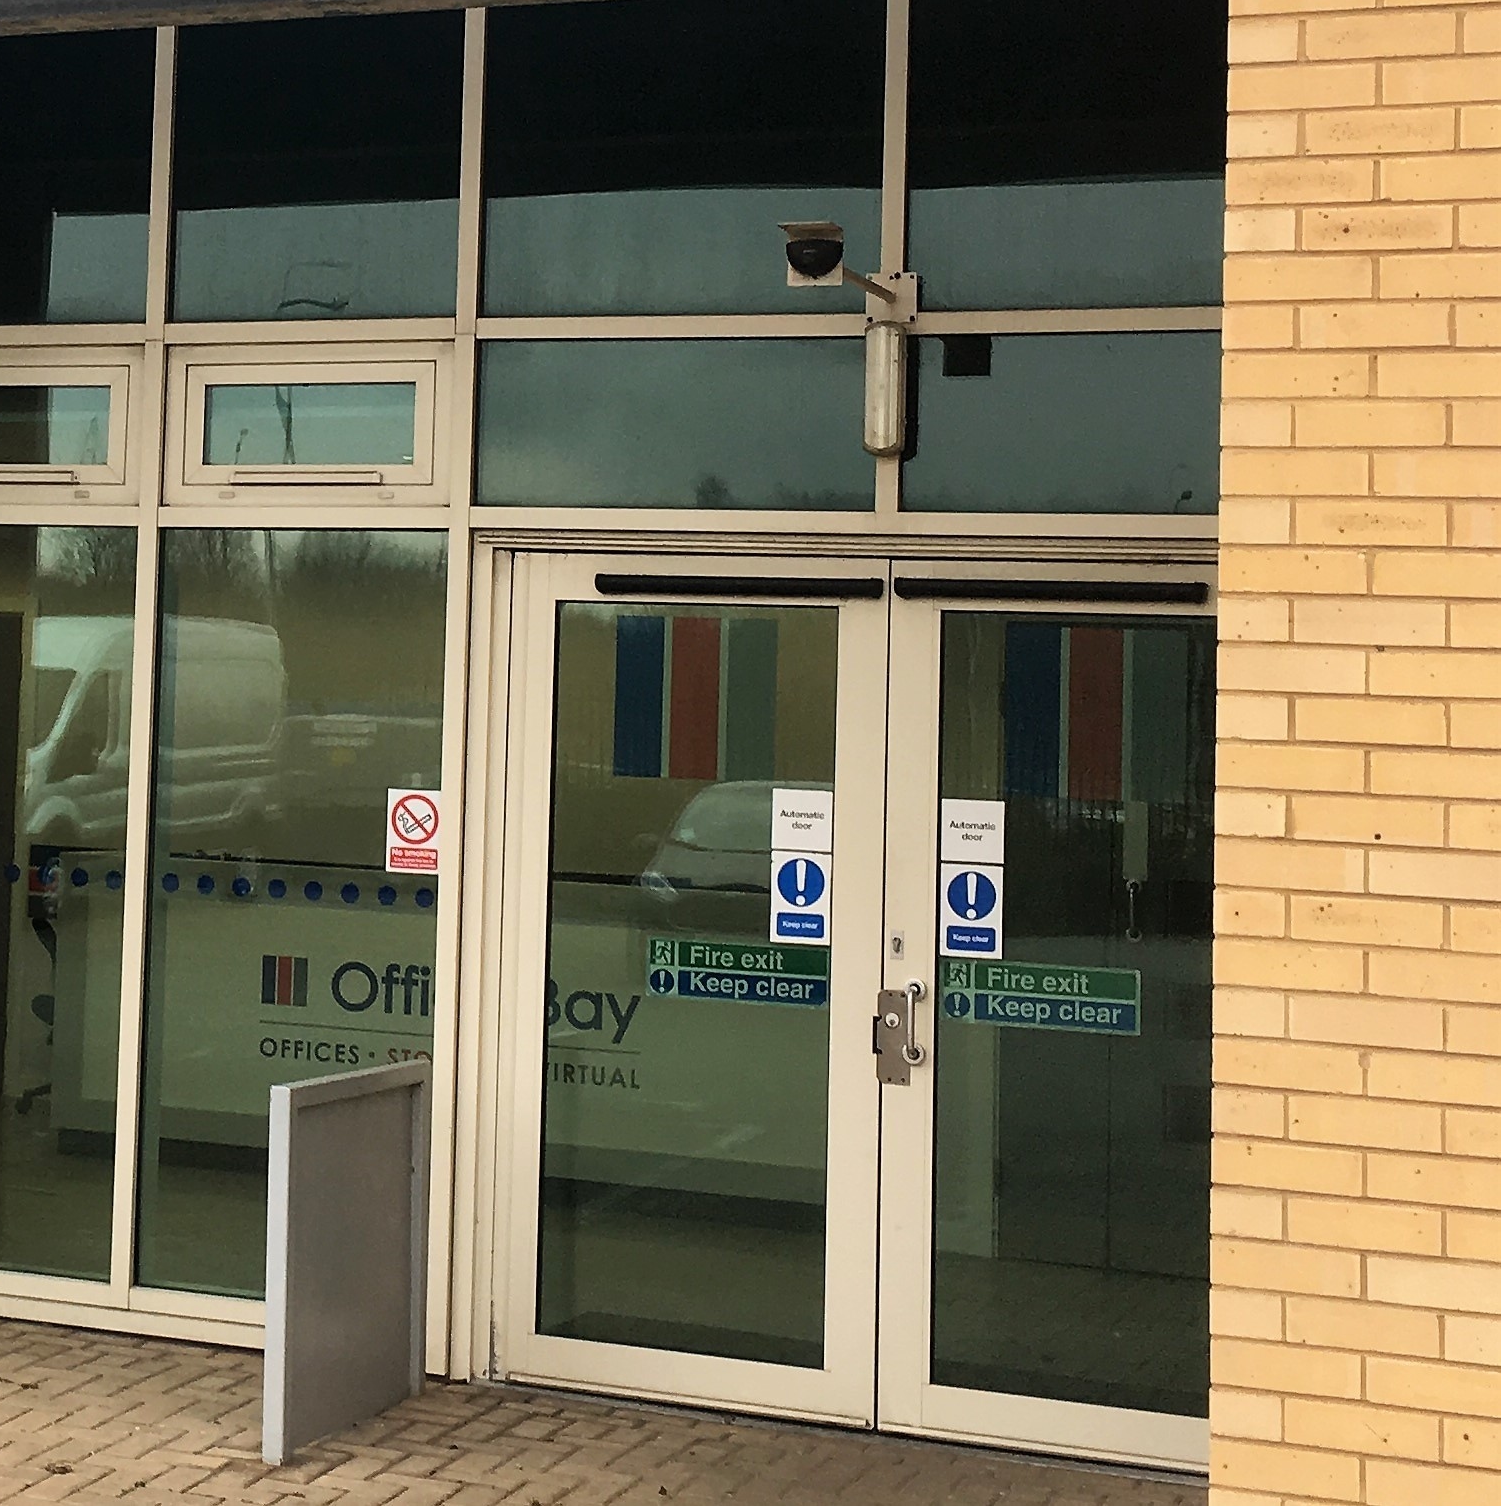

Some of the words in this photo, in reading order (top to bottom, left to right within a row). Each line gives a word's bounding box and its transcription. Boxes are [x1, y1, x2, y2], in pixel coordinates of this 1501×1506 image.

[779, 809, 825, 820] Automatic
[791, 821, 813, 830] door
[949, 820, 996, 831] Automatic
[961, 832, 983, 842] door
[782, 920, 801, 930] Keep
[801, 921, 819, 930] clear
[952, 933, 971, 943] Keep
[972, 935, 989, 944] clear
[689, 945, 734, 968] Fire
[741, 950, 784, 971] exit
[331, 961, 435, 1017] Offi
[689, 972, 749, 999] Keep
[755, 977, 815, 1000] clear
[987, 967, 1036, 991] Fire
[1042, 972, 1089, 995] exit
[987, 995, 1051, 1024] Keep
[1059, 1001, 1122, 1025] clear
[259, 1037, 360, 1065] OFFICES
[548, 1062, 641, 1090] IRTUAL
